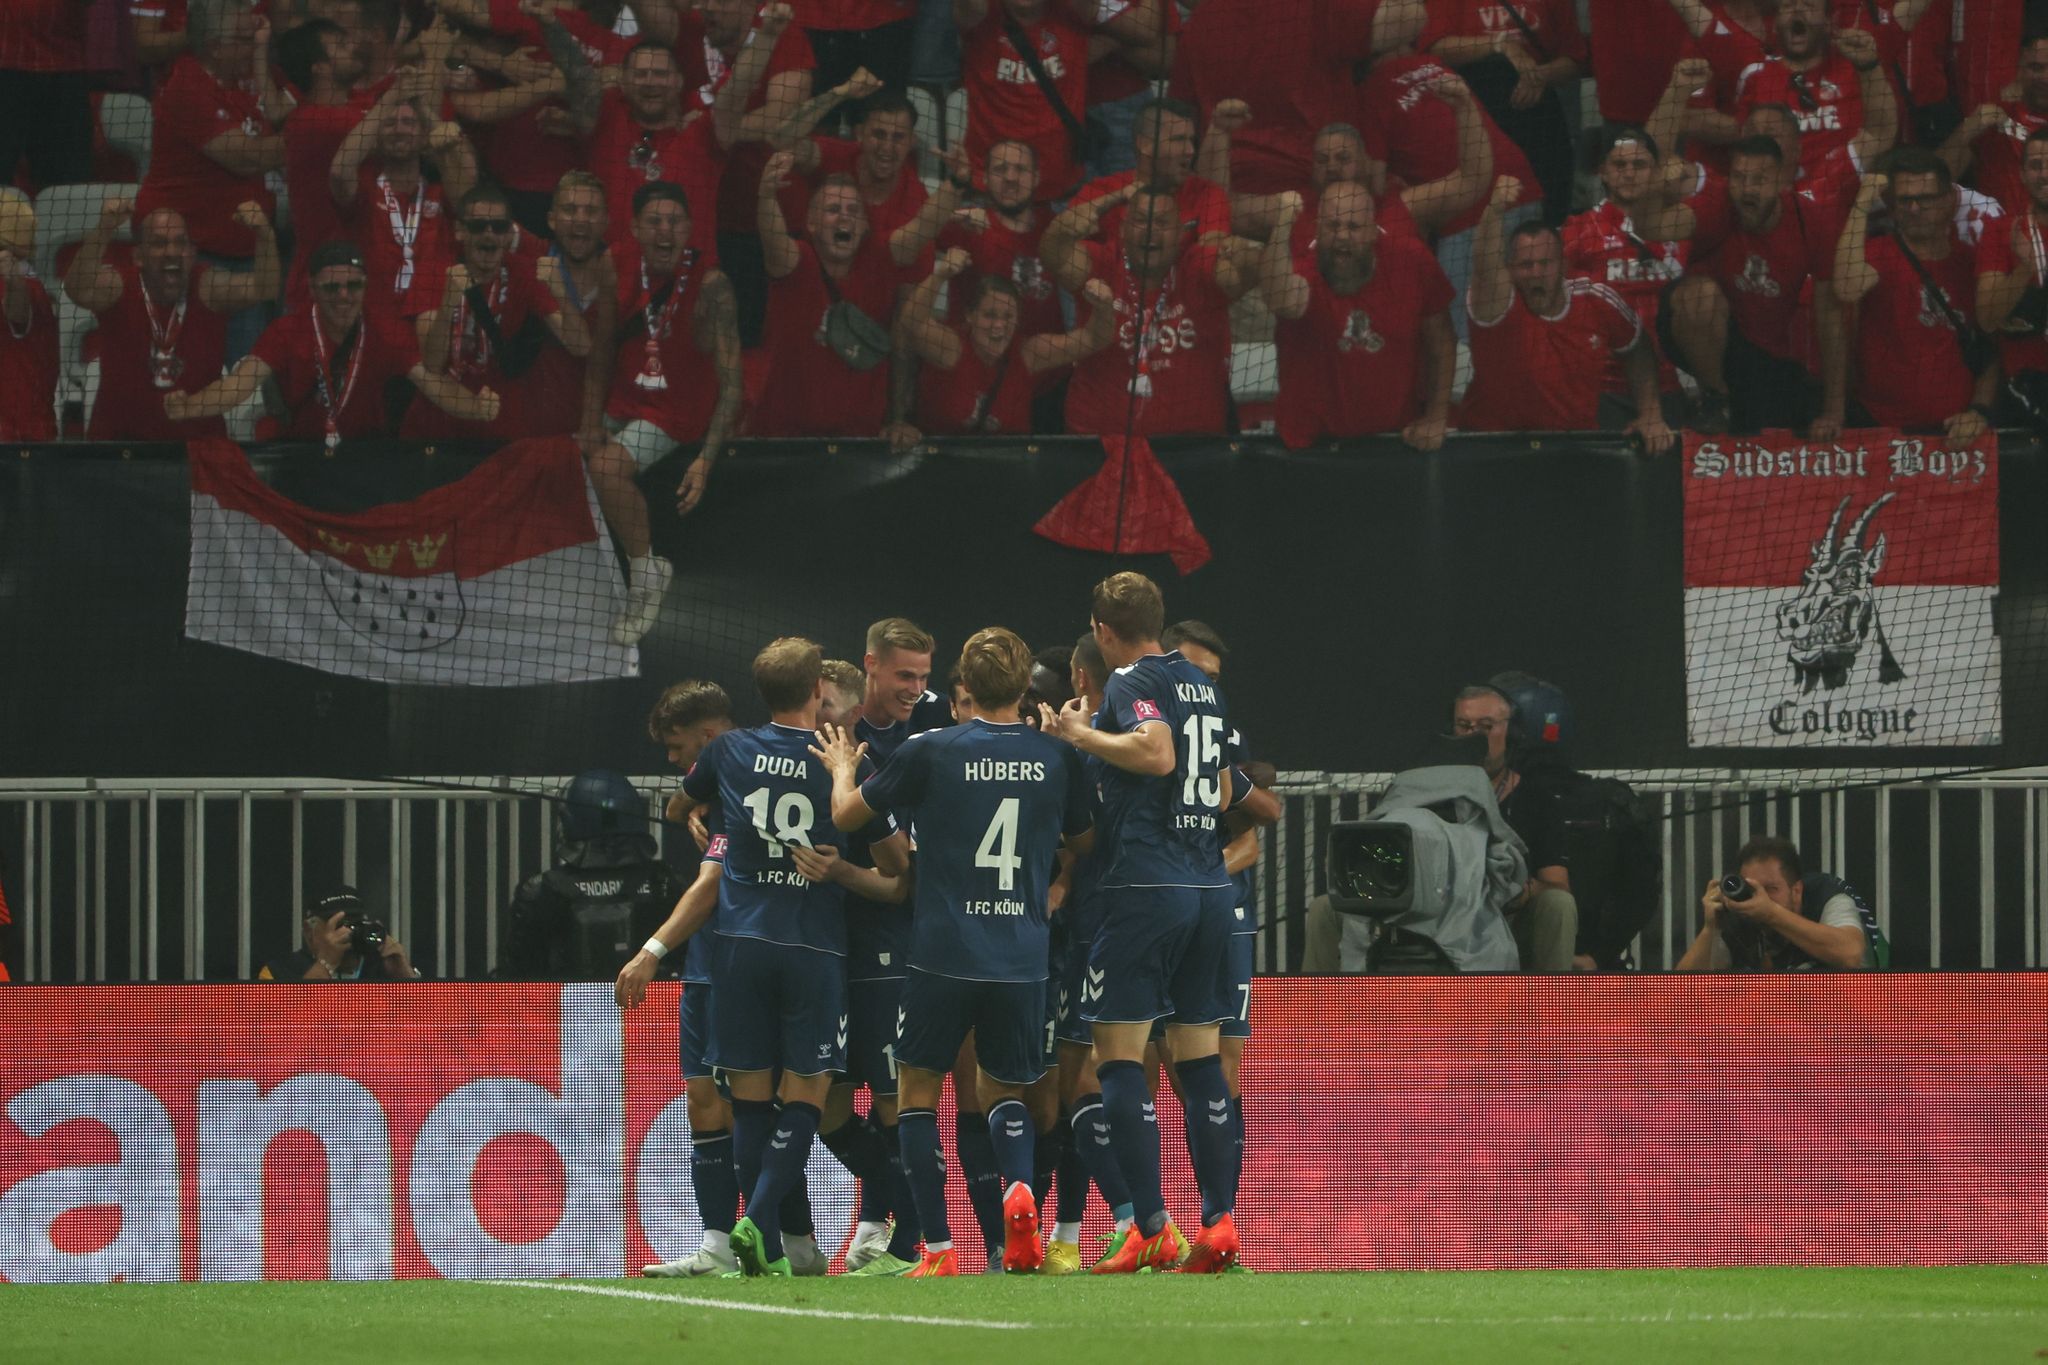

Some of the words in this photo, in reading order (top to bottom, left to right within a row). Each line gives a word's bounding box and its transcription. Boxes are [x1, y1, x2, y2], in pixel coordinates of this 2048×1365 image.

[1692, 443, 1868, 478] Südstadt
[1768, 700, 1918, 741] Cologne
[753, 754, 808, 780] DUDA
[965, 758, 1045, 782] HÜBERS
[1183, 714, 1224, 808] 15
[743, 787, 815, 858] 18
[975, 797, 1022, 891] 4
[994, 898, 1025, 916] KÖLN
